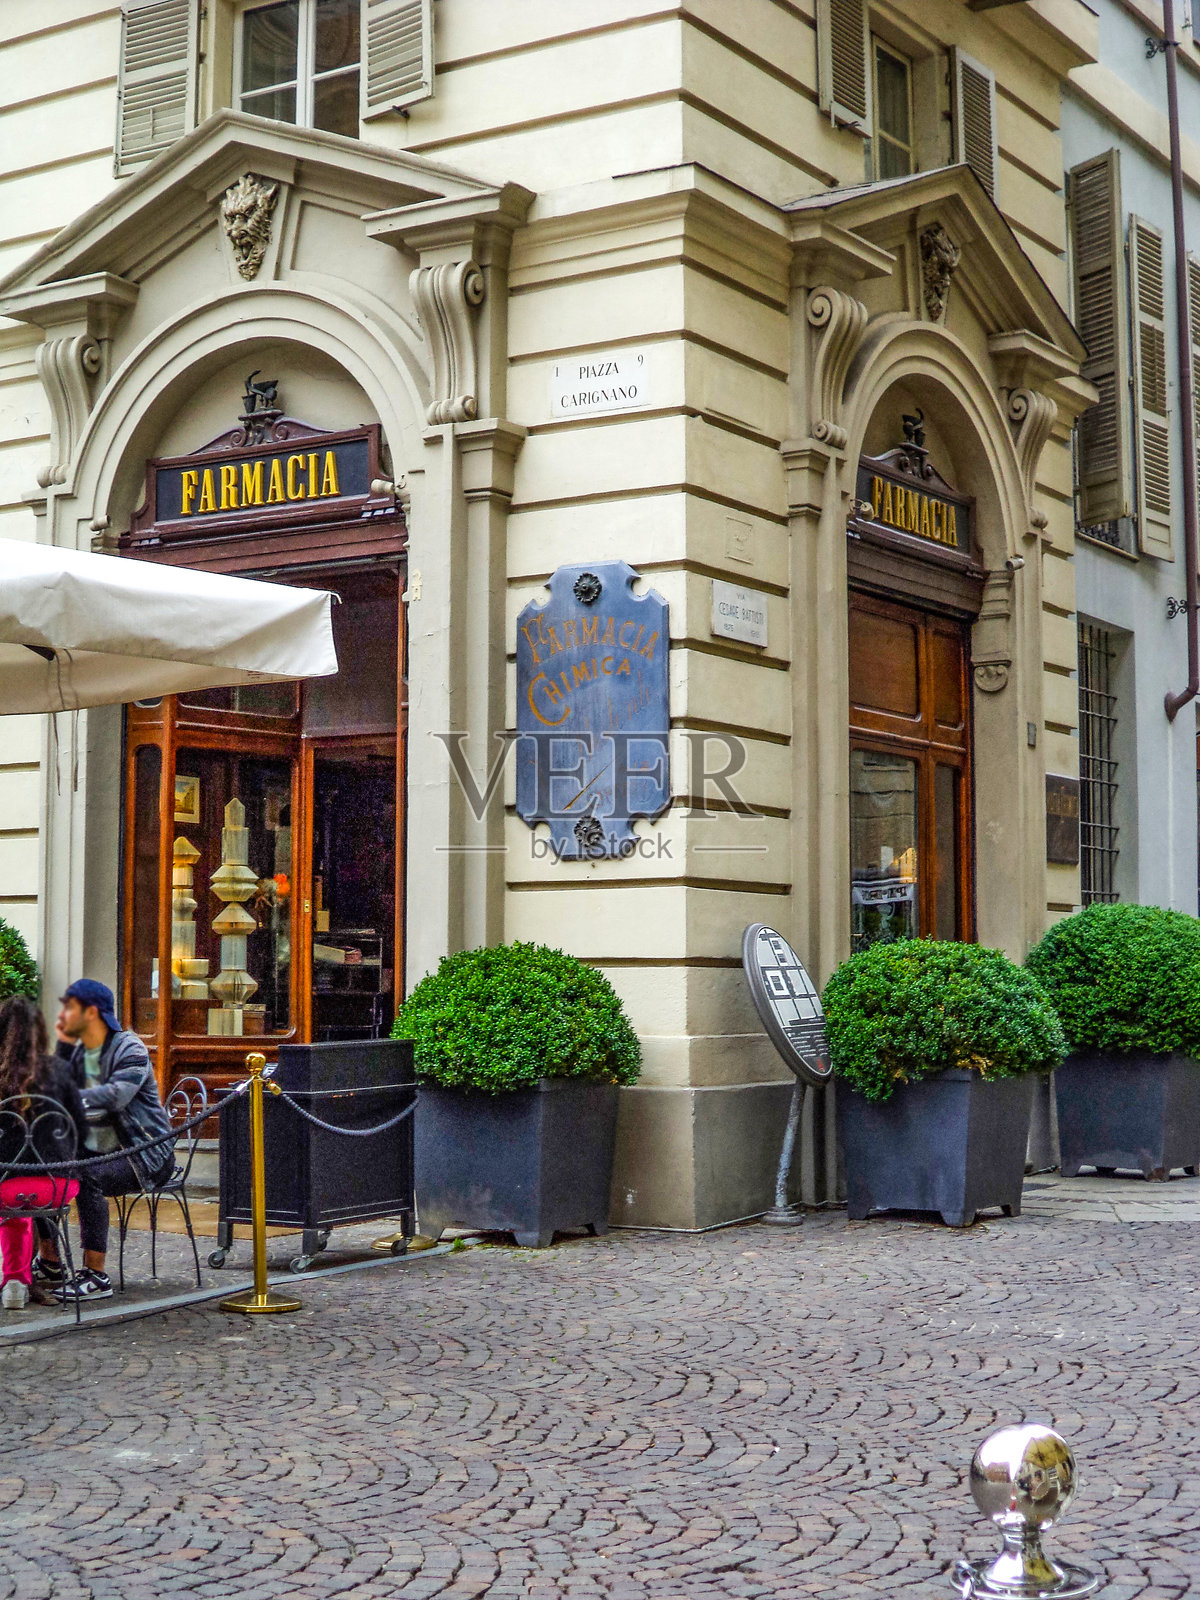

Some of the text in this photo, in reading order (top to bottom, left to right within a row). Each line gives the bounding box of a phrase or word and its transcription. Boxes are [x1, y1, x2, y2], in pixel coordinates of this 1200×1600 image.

[560, 385, 638, 408] CARIGNANO
[579, 362, 619, 379] PIAZZA
[637, 353, 644, 367] 9
[180, 450, 342, 516] FARMACIA
[871, 474, 959, 548] FARMACIA
[521, 613, 660, 671] FARMACIA
[528, 656, 632, 726] CHIMICA
